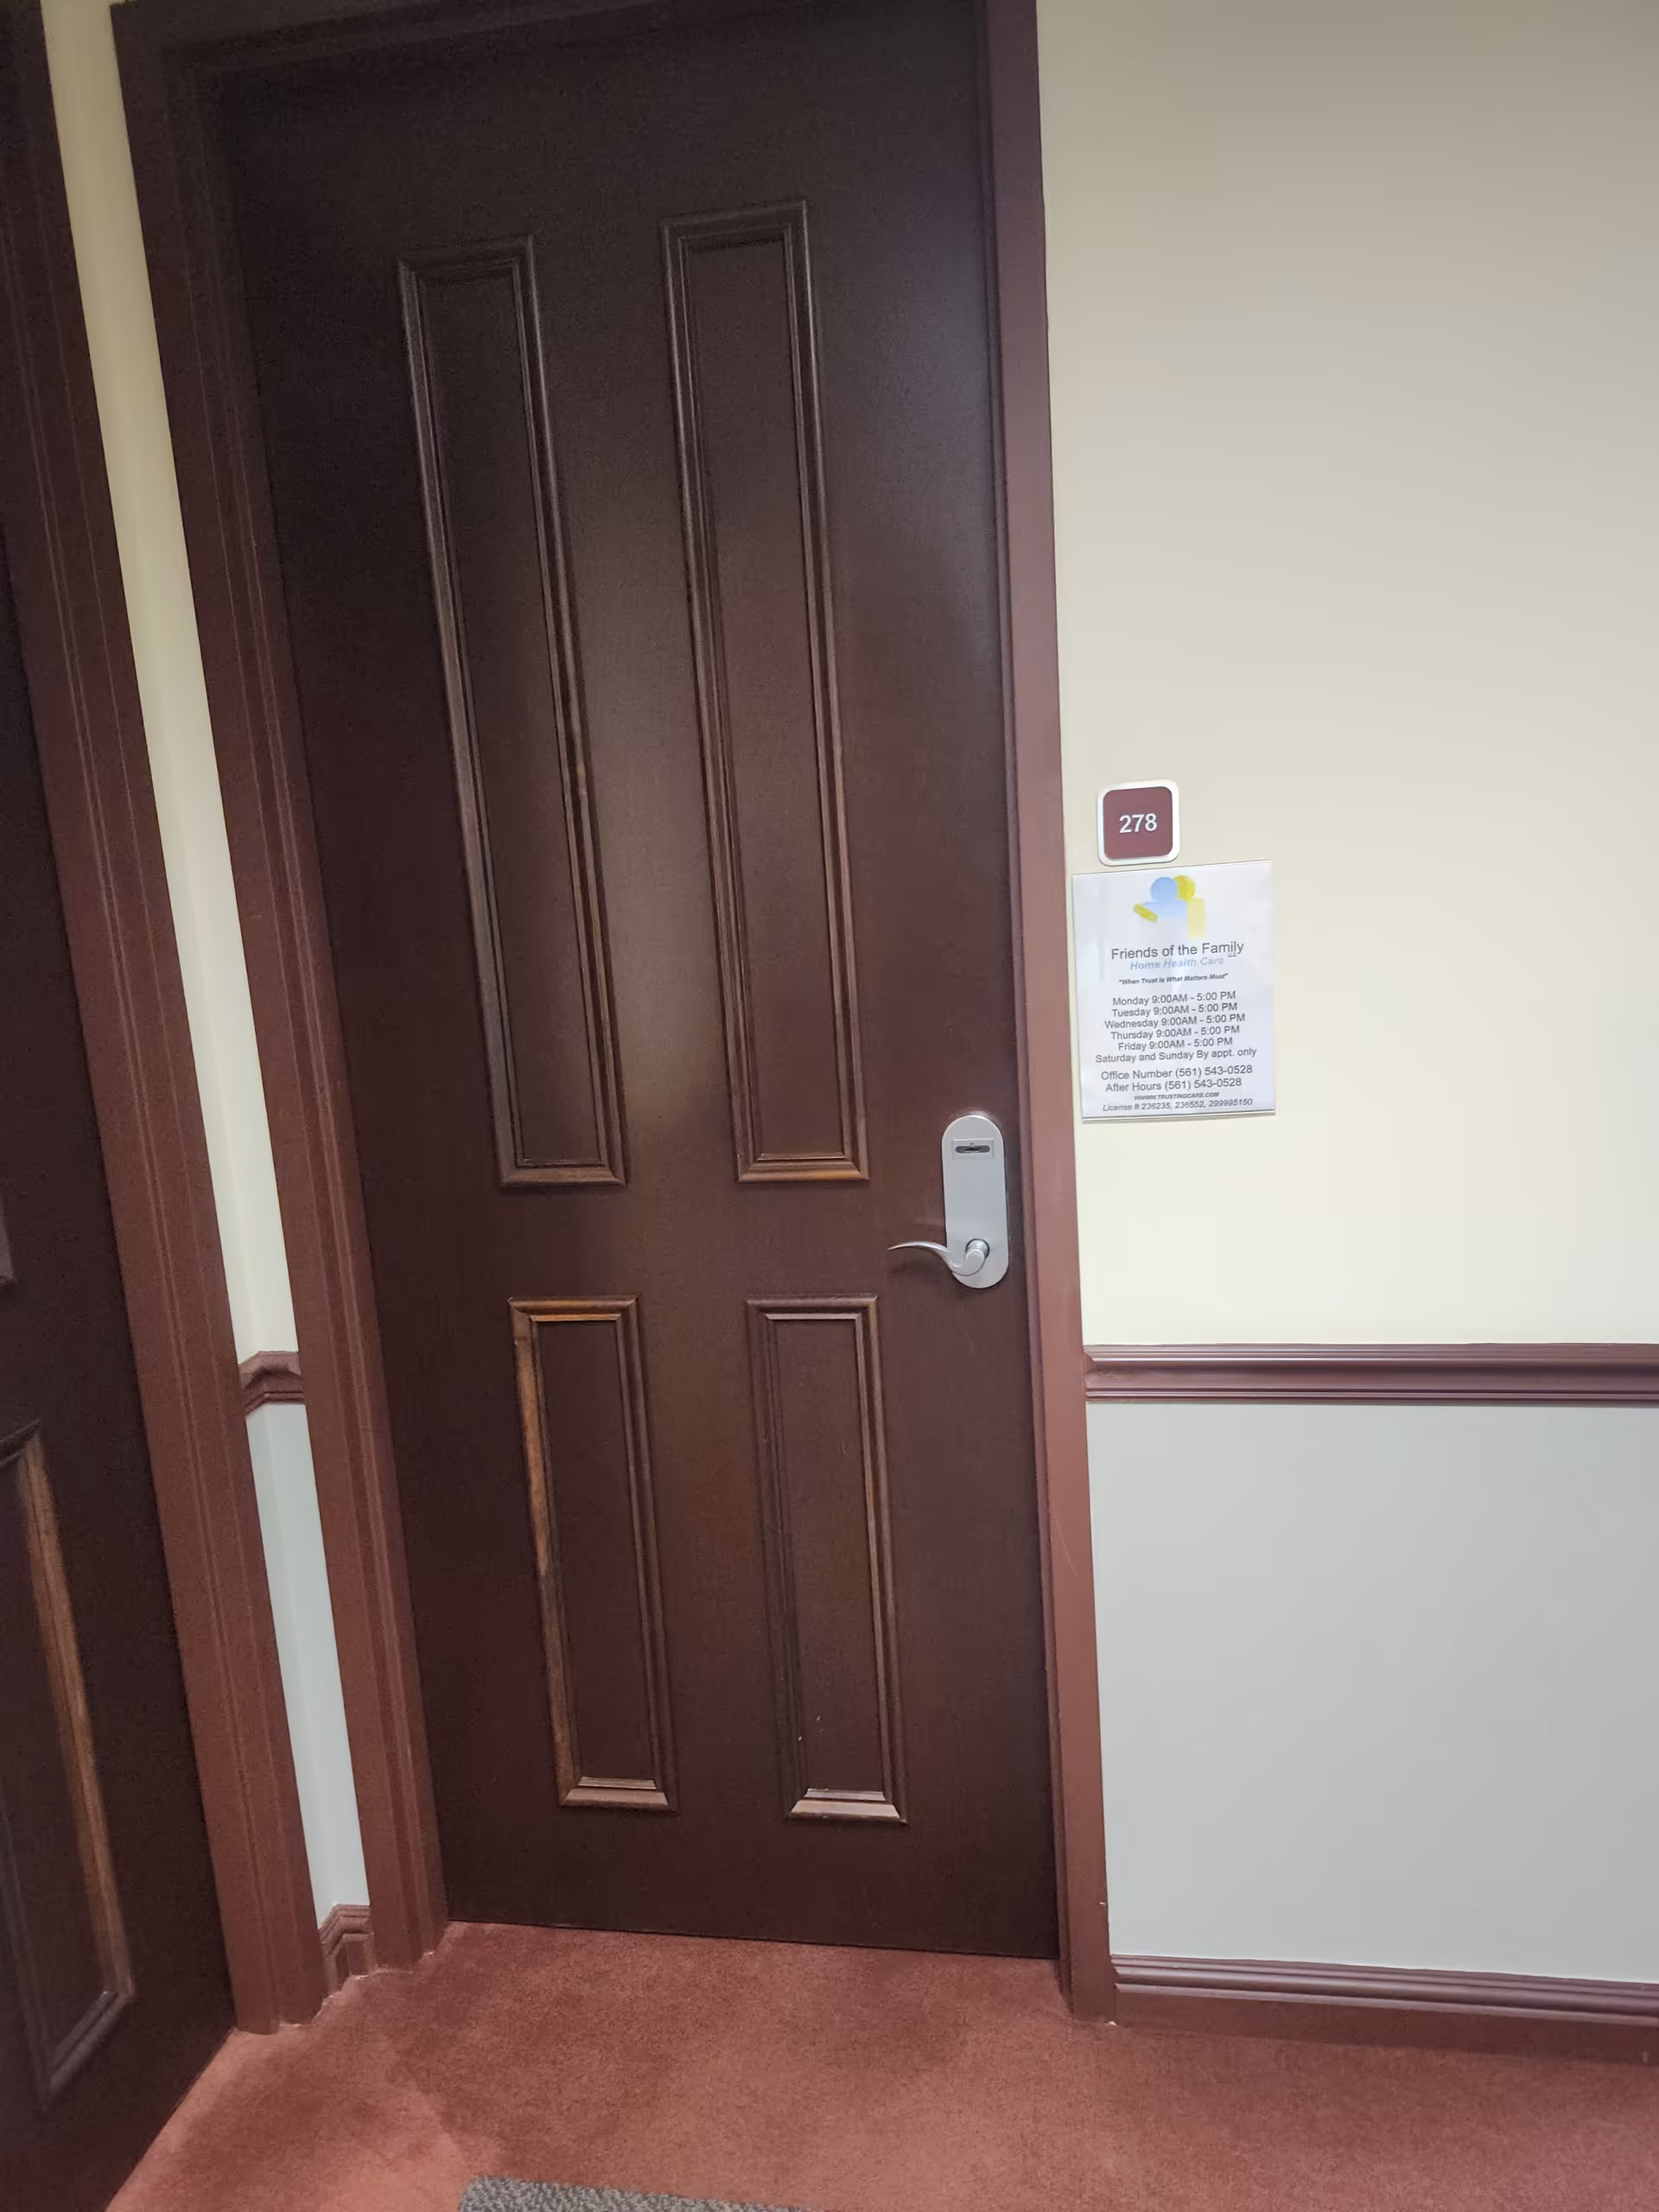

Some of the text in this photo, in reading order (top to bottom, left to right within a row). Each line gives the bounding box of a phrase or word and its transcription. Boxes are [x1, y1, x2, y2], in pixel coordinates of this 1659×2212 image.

[1119, 813, 1158, 834] 278
[1111, 941, 1244, 959] Friends of the Family
[1130, 957, 1224, 970] Home Health Care
[1112, 996, 1149, 1006] Monday
[1152, 994, 1187, 1003] 9:00AM
[1197, 992, 1217, 1001] 5:00
[1220, 991, 1236, 1000] PM
[1111, 1008, 1151, 1017] Tuesday
[1154, 1006, 1189, 1014] 9:00AM
[1198, 1004, 1218, 1013] 5:00
[1221, 1002, 1237, 1011] PM
[1104, 1020, 1159, 1029] Wednesday
[1161, 1016, 1197, 1026] 9:00AM
[1206, 1015, 1227, 1024] 5:00
[1230, 1014, 1245, 1022] PM
[1110, 1031, 1154, 1039] Thursday
[1155, 1028, 1192, 1038] 9:00AM
[1201, 1027, 1221, 1035] 5:00
[1224, 1026, 1240, 1034] PM
[1118, 1042, 1147, 1052] Friday
[1149, 1039, 1185, 1050] 9:00AM
[1193, 1038, 1214, 1047] 5:00
[1217, 1037, 1233, 1046] PM
[1096, 1047, 1257, 1064] Saturday and Sunday By appt. only
[1101, 1065, 1253, 1080] Office Number (561) 543-0528
[1105, 1077, 1243, 1092] After Hours (561) 543-0528
